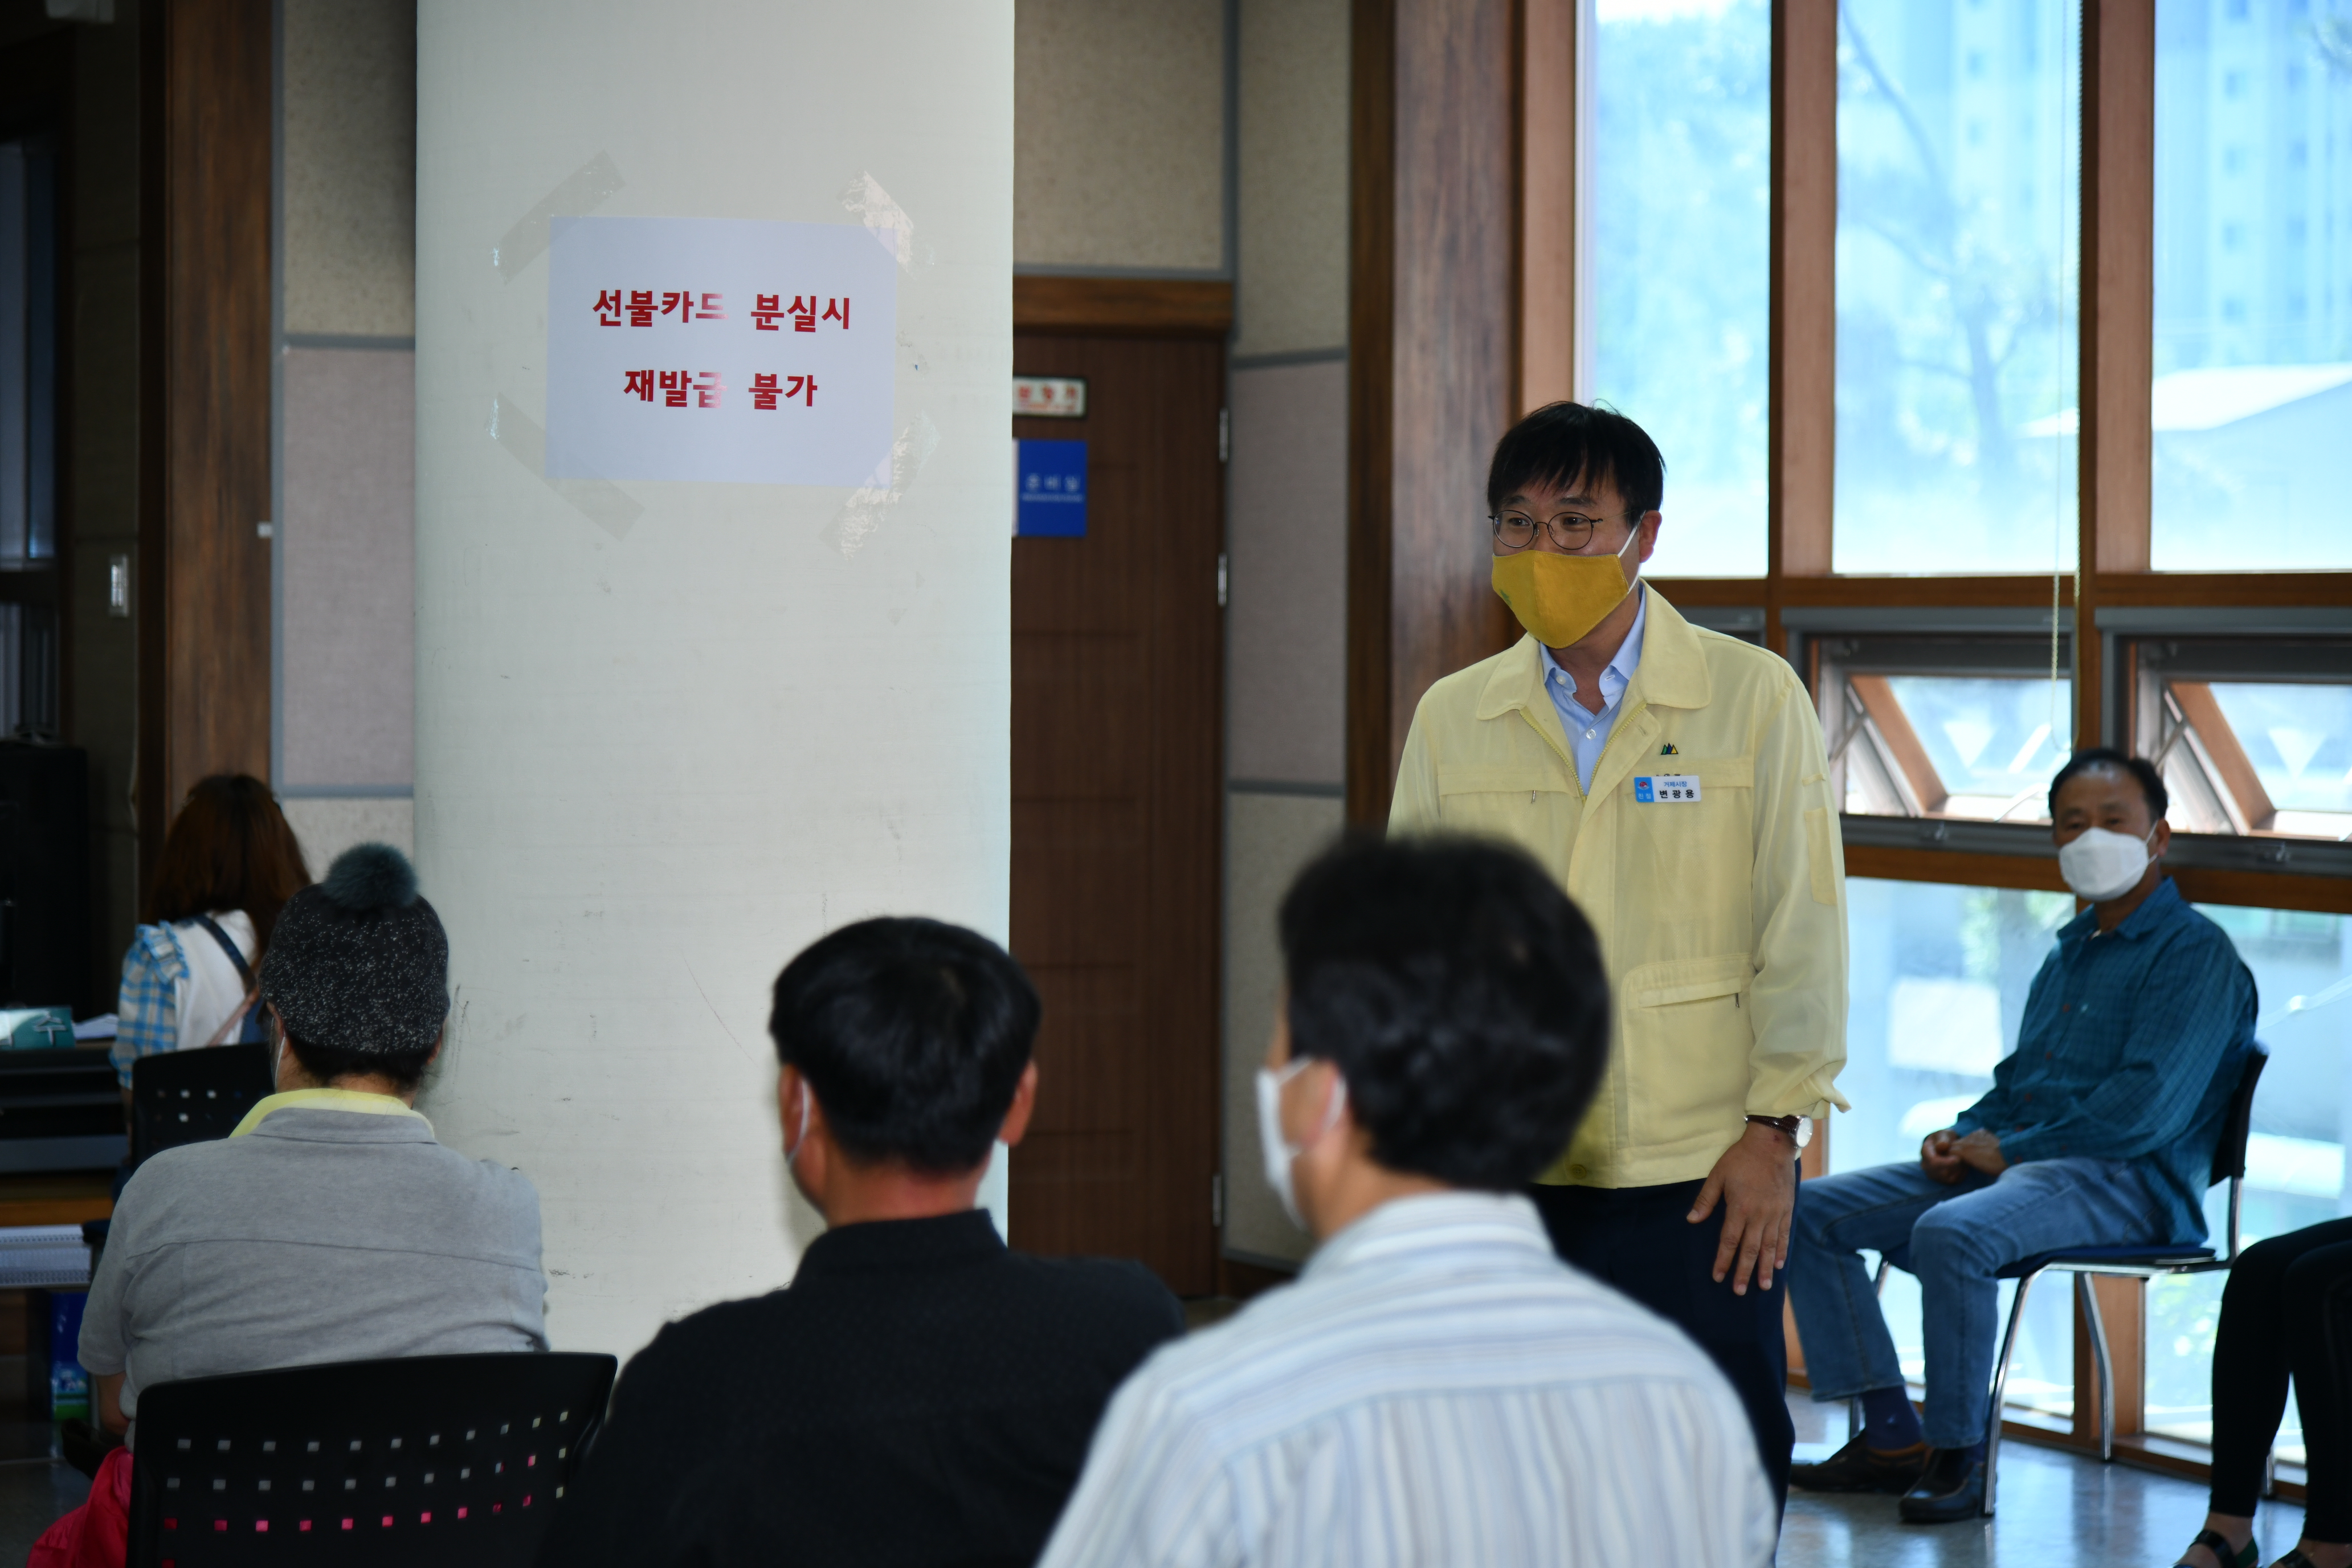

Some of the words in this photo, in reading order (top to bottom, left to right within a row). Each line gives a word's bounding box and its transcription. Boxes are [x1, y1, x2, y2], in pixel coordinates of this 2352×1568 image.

[593, 289, 729, 328] 선불카드
[750, 293, 850, 333] 분실시
[623, 369, 728, 409] 재발급
[748, 373, 818, 411] 불가
